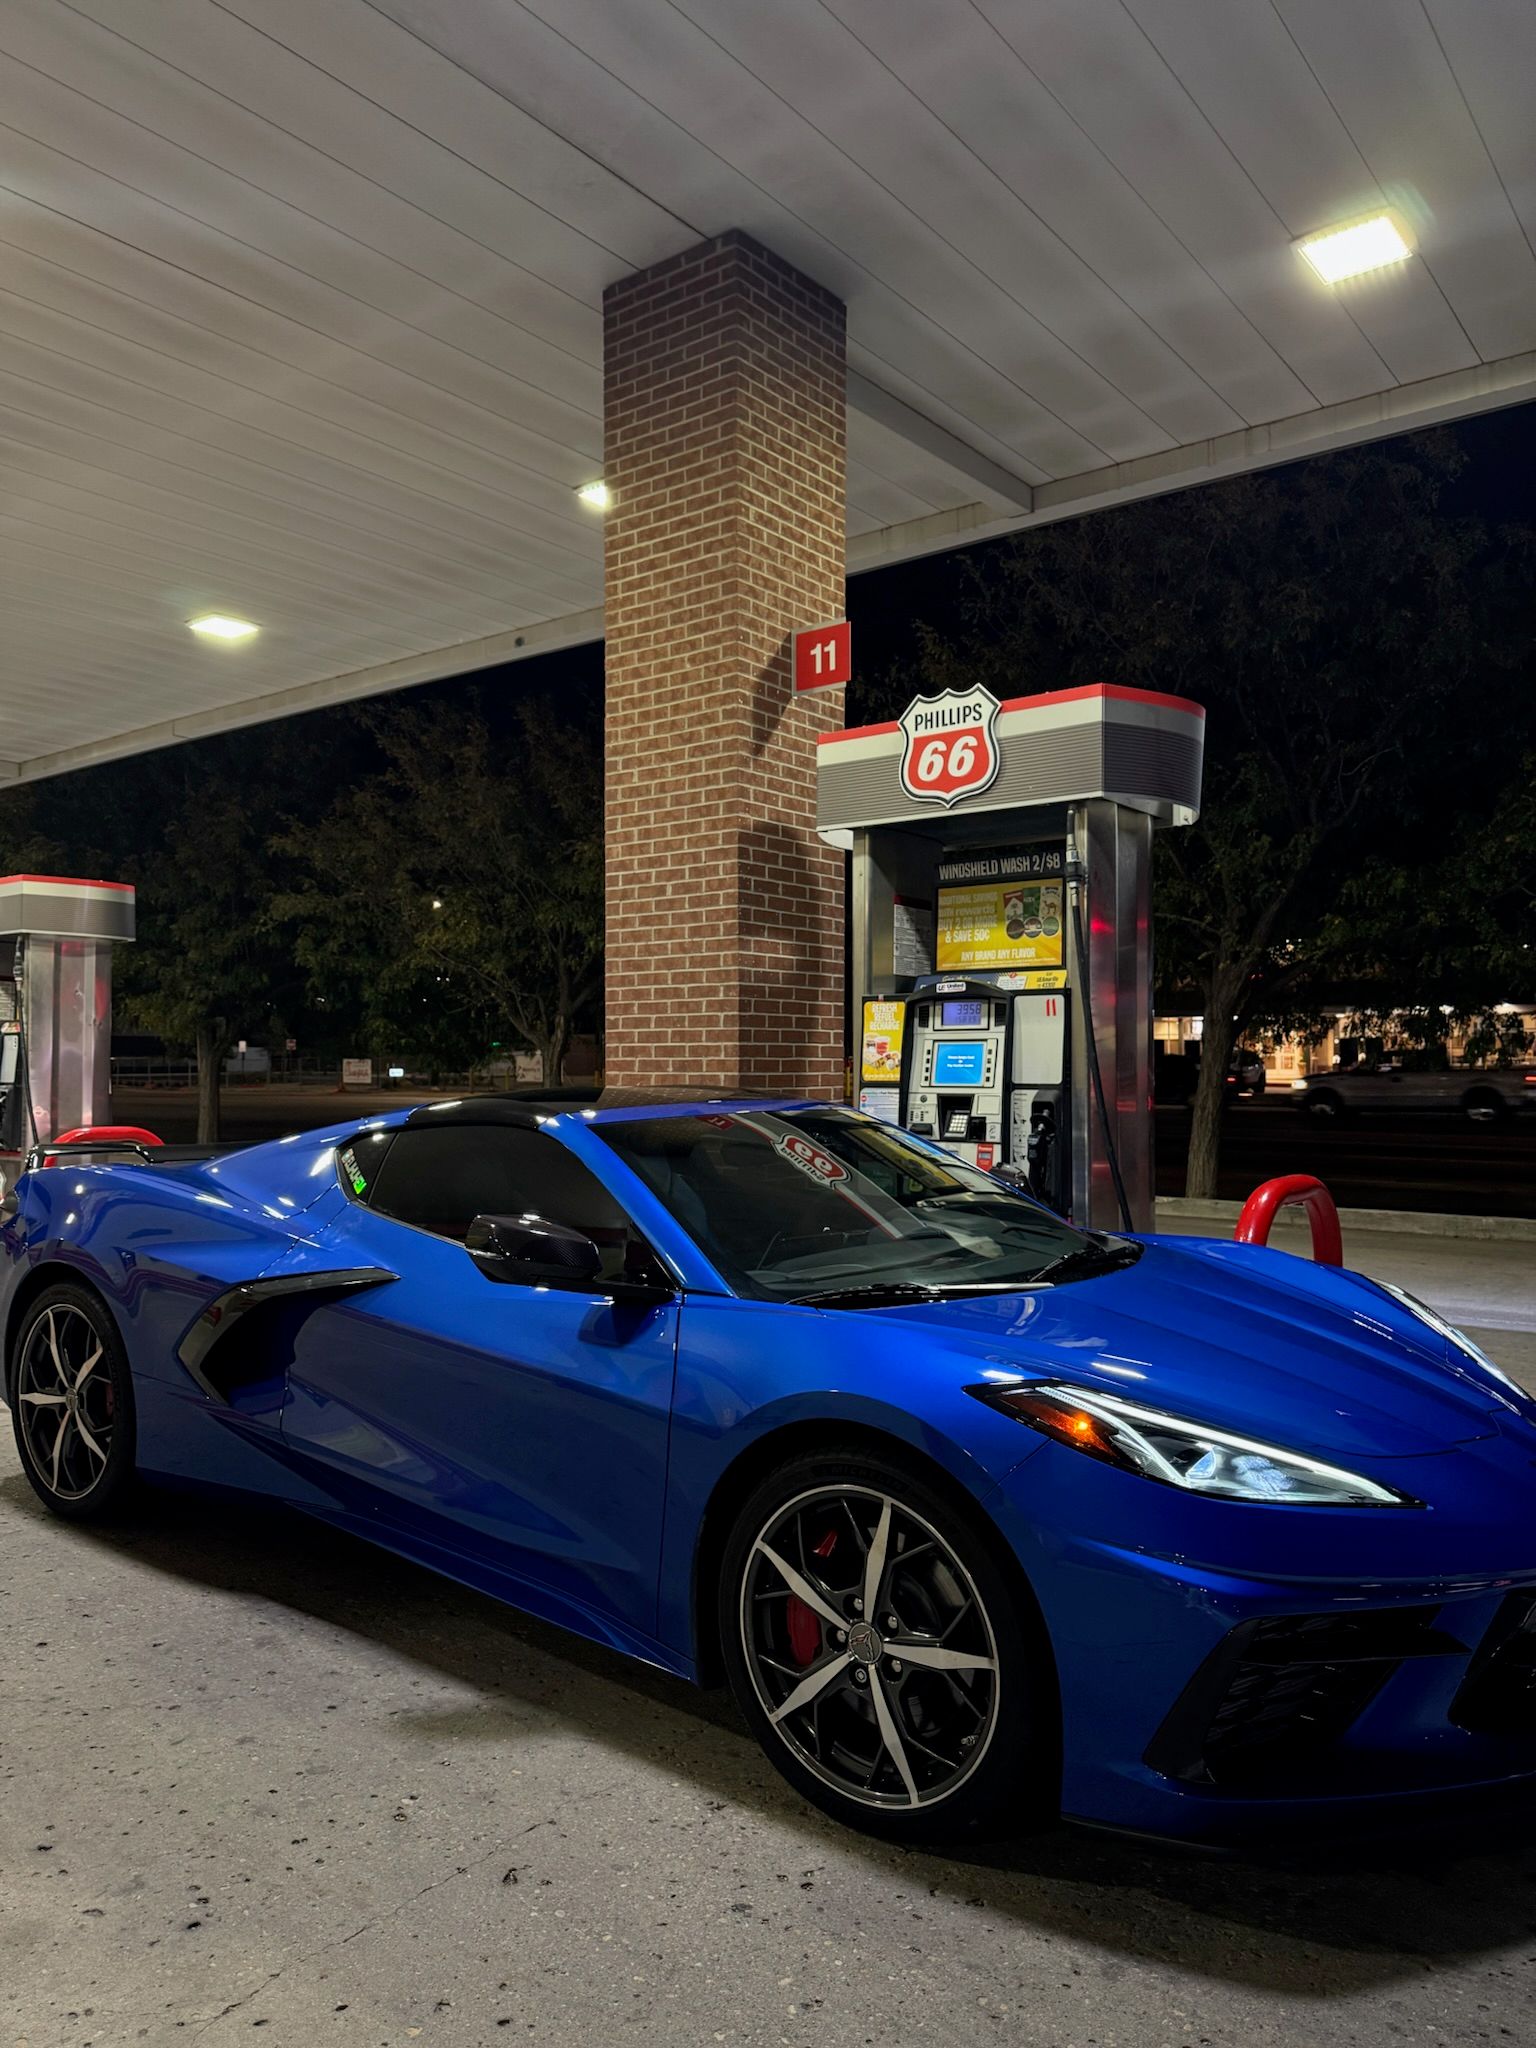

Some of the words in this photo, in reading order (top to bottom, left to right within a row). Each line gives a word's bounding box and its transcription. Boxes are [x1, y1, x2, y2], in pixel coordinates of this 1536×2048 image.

[810, 640, 835, 674] 11
[914, 703, 983, 732] PHILLIPS
[917, 735, 978, 782] 66
[938, 860, 998, 880] WINDSHIELD
[1000, 856, 1030, 874] WASH
[1032, 852, 1061, 873] 2/$8
[945, 931, 951, 944] &
[953, 930, 973, 943] SAVE
[955, 918, 961, 930] 2
[961, 952, 974, 962] ANY
[975, 950, 997, 961] BRAND
[998, 949, 1011, 960] ANY
[1012, 947, 1036, 959] FLAVOR
